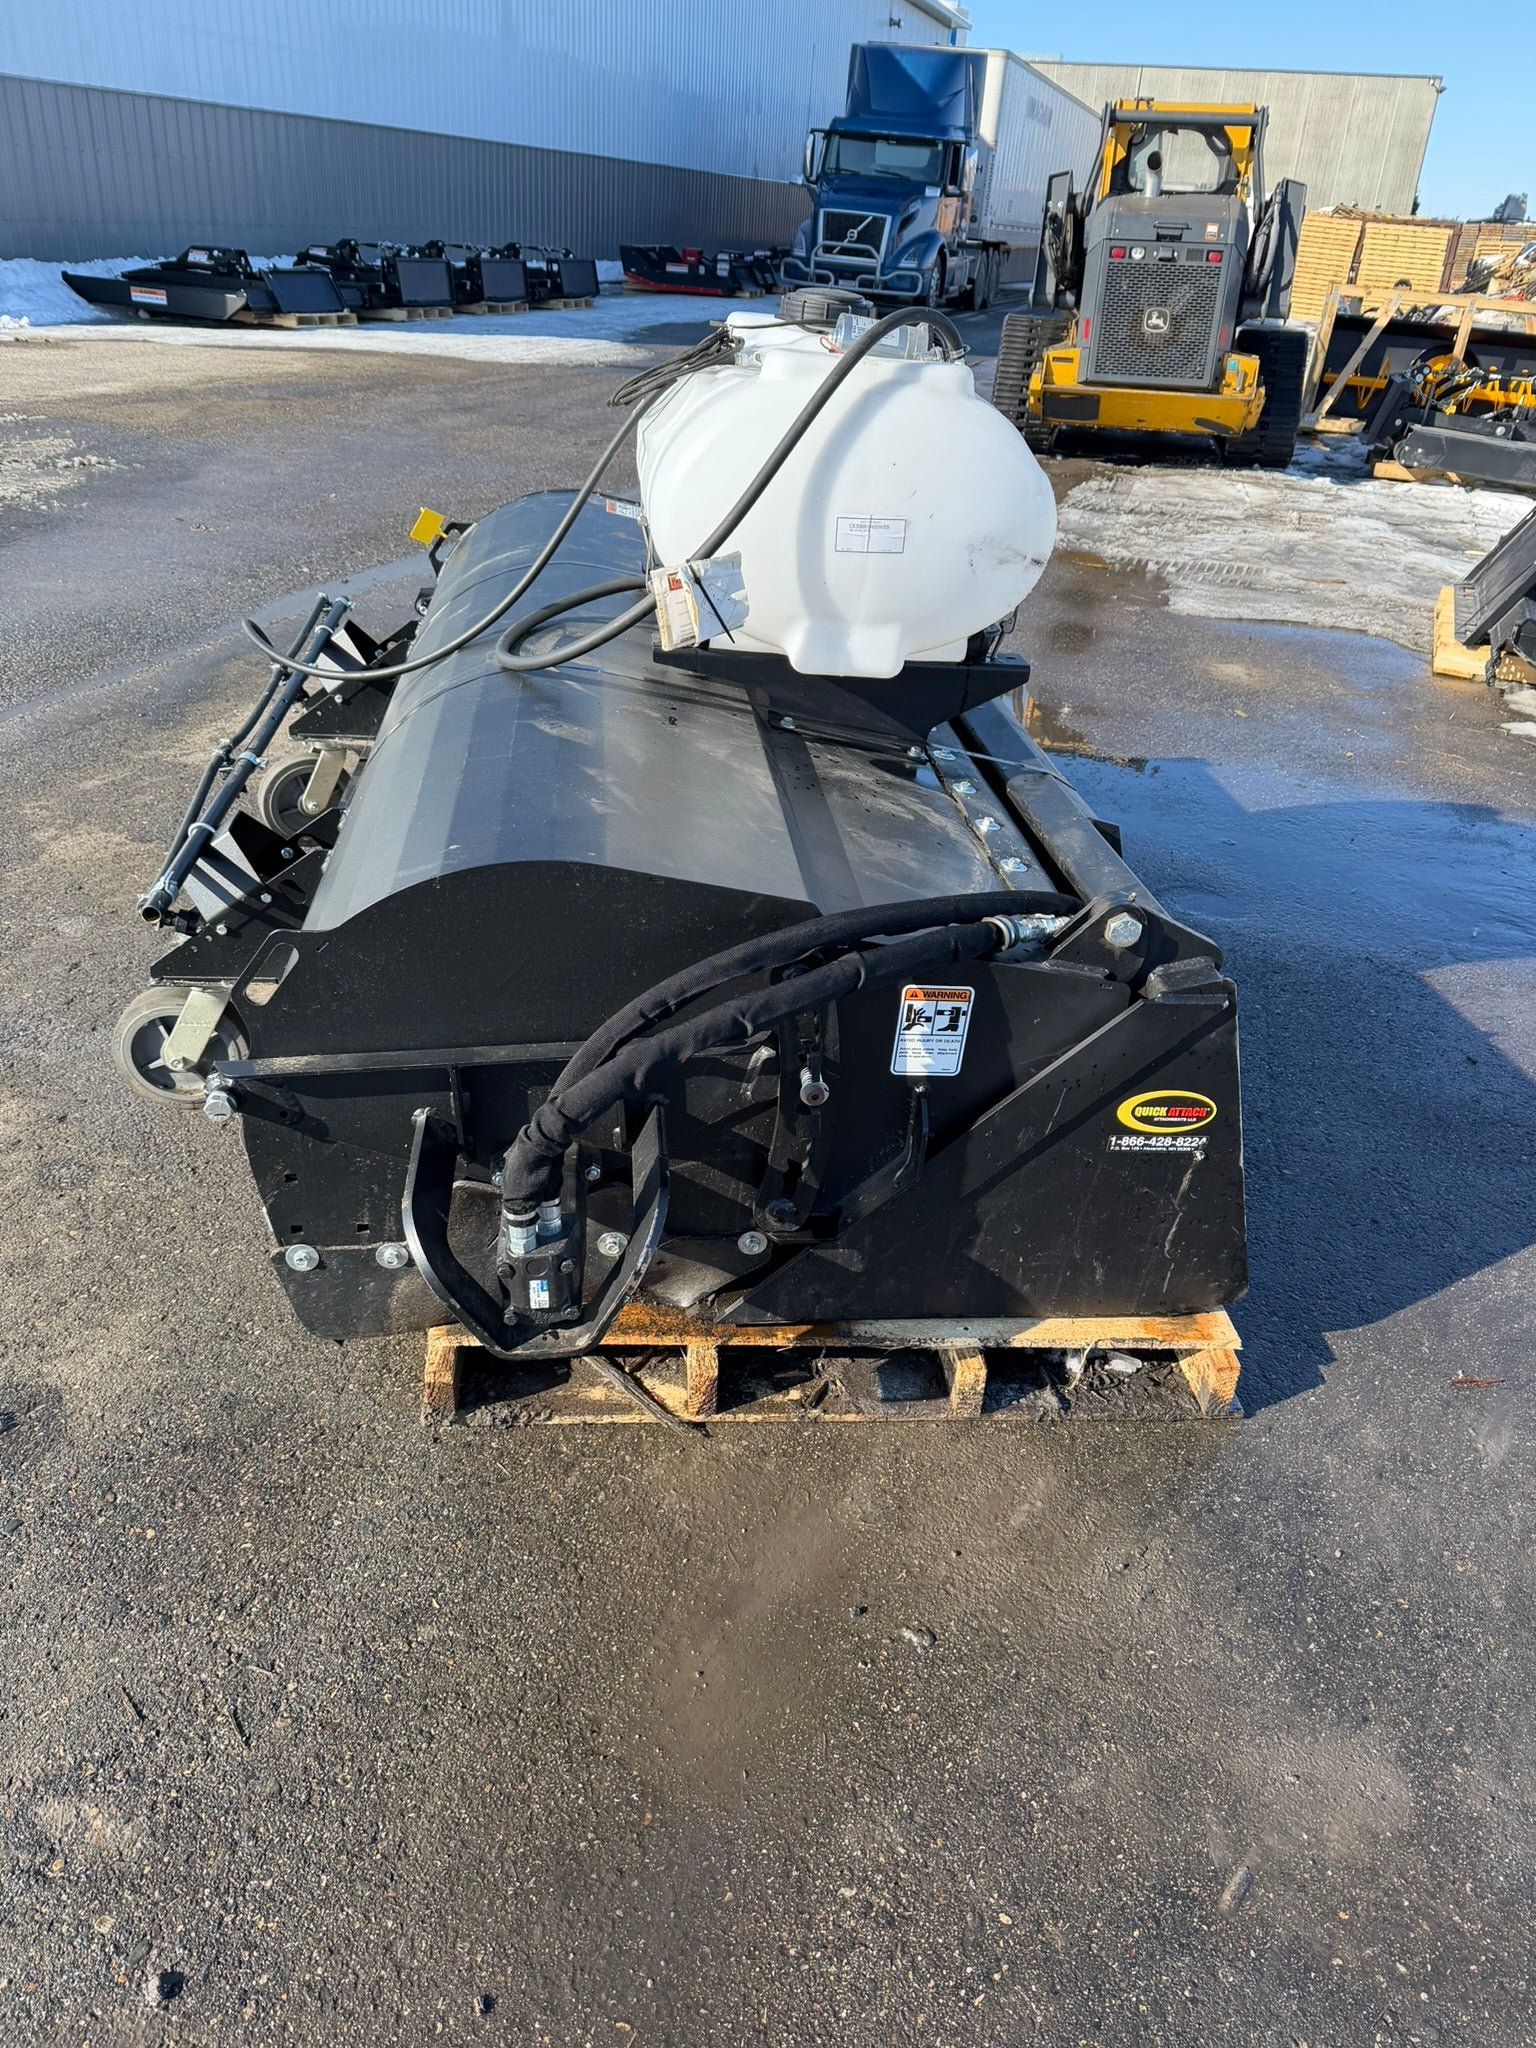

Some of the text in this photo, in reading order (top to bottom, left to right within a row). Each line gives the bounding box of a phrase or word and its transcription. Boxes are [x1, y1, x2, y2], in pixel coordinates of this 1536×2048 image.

[922, 991, 967, 999] WARNING
[1134, 1106, 1207, 1117] QUICK ATTACH
